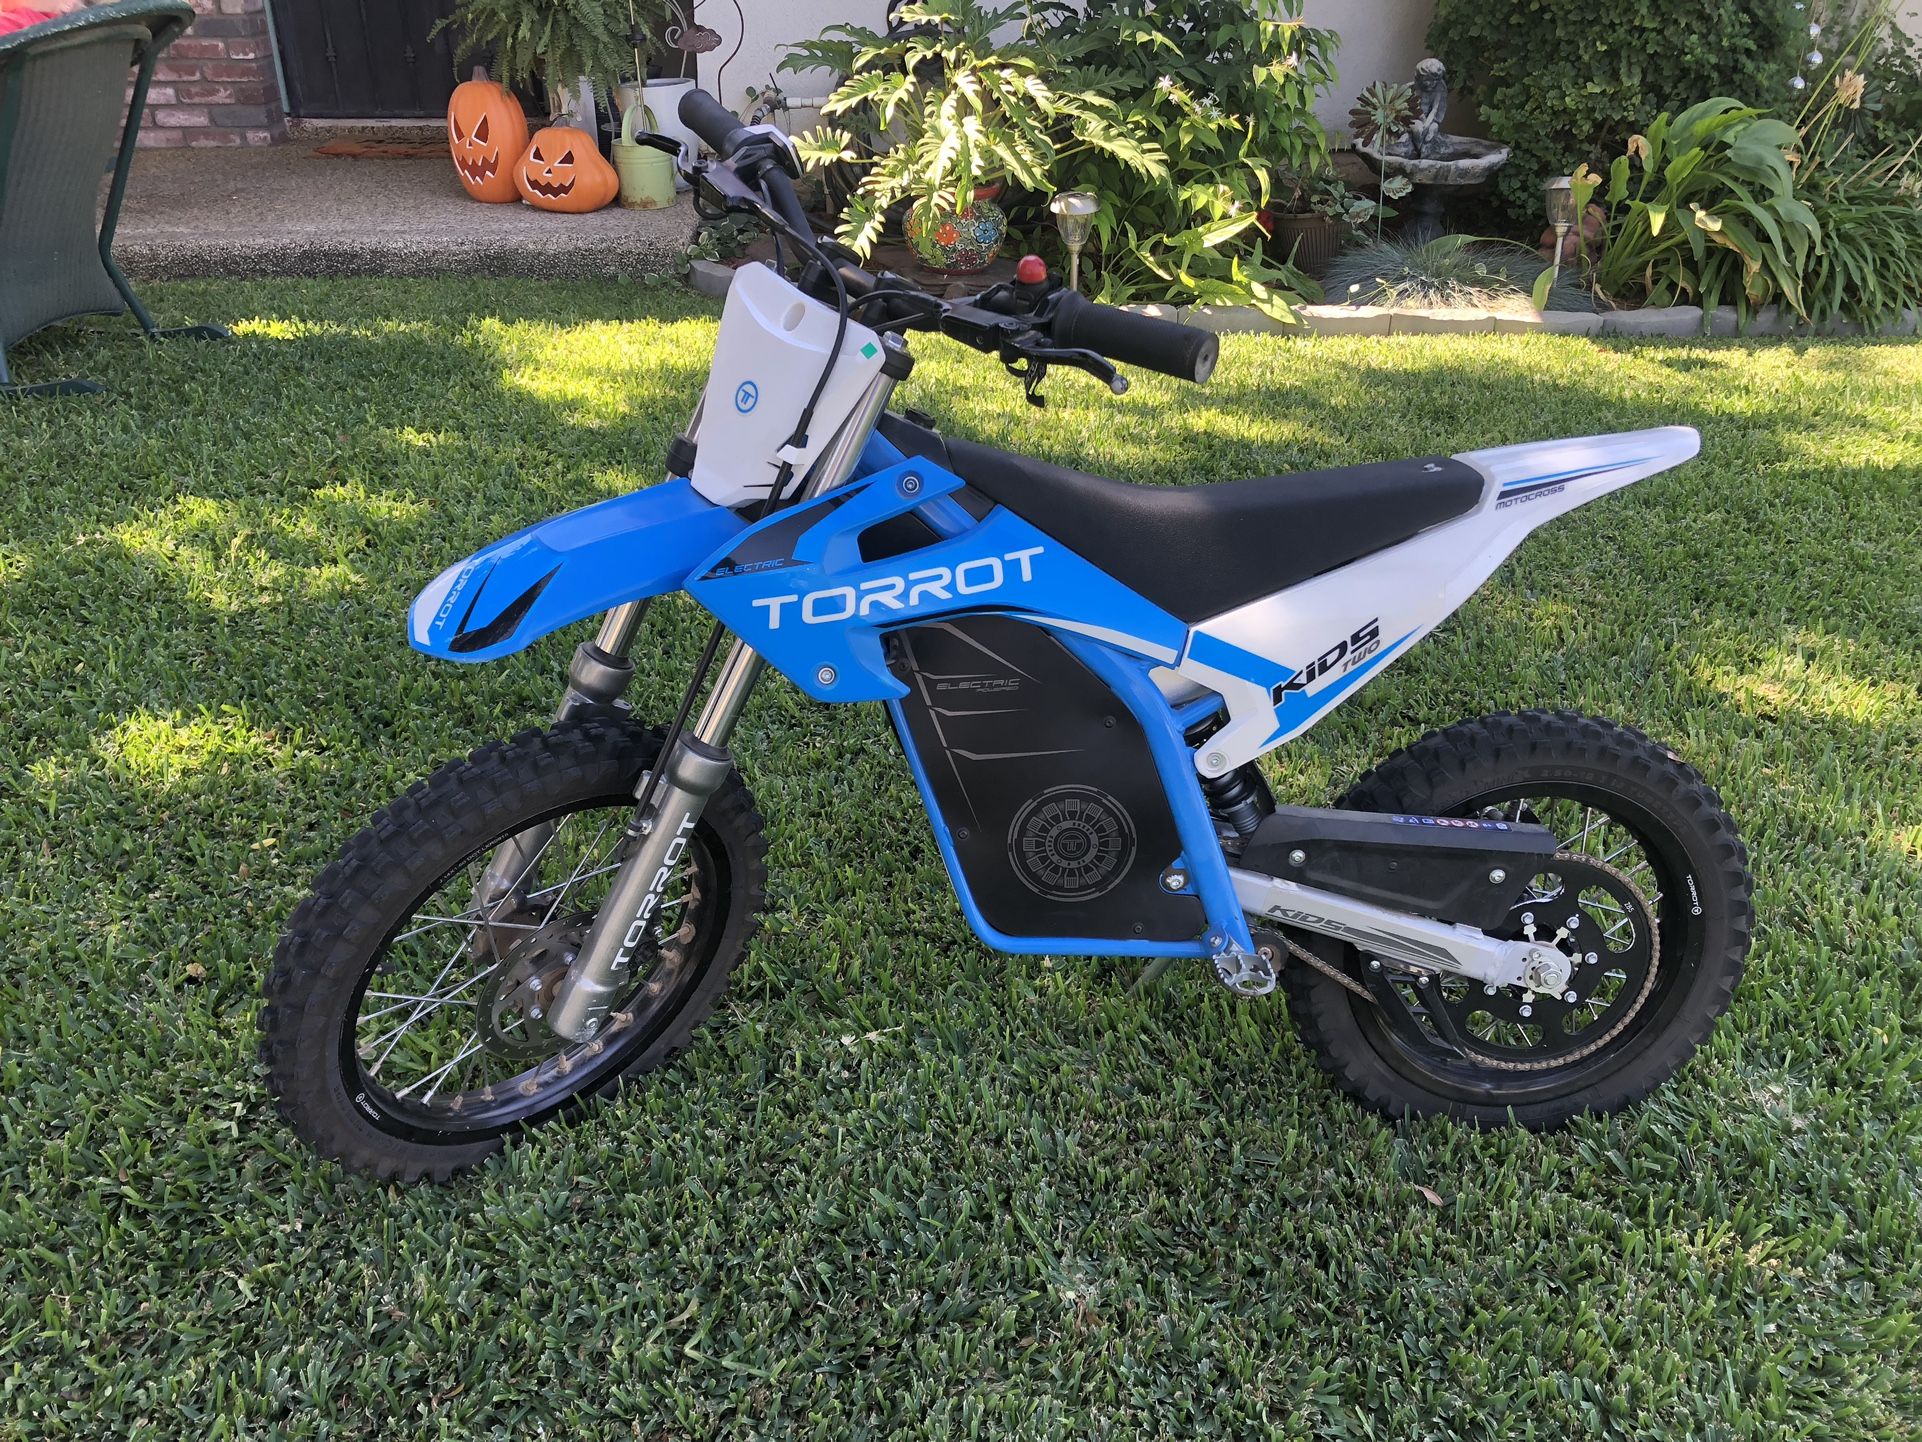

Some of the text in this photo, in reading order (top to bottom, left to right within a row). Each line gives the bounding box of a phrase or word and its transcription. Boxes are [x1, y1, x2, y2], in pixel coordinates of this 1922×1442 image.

[1495, 485, 1566, 511] MOTOCROSS
[715, 558, 785, 576] ELECTRIC
[435, 560, 480, 631] ORROT
[752, 546, 1045, 630] TORROT
[1341, 639, 1381, 673] TWO
[936, 678, 1021, 691] ELECTRIC
[611, 812, 696, 970] TORROT
[1686, 874, 1699, 906] TORROT
[360, 1100, 381, 1121] TORROT
